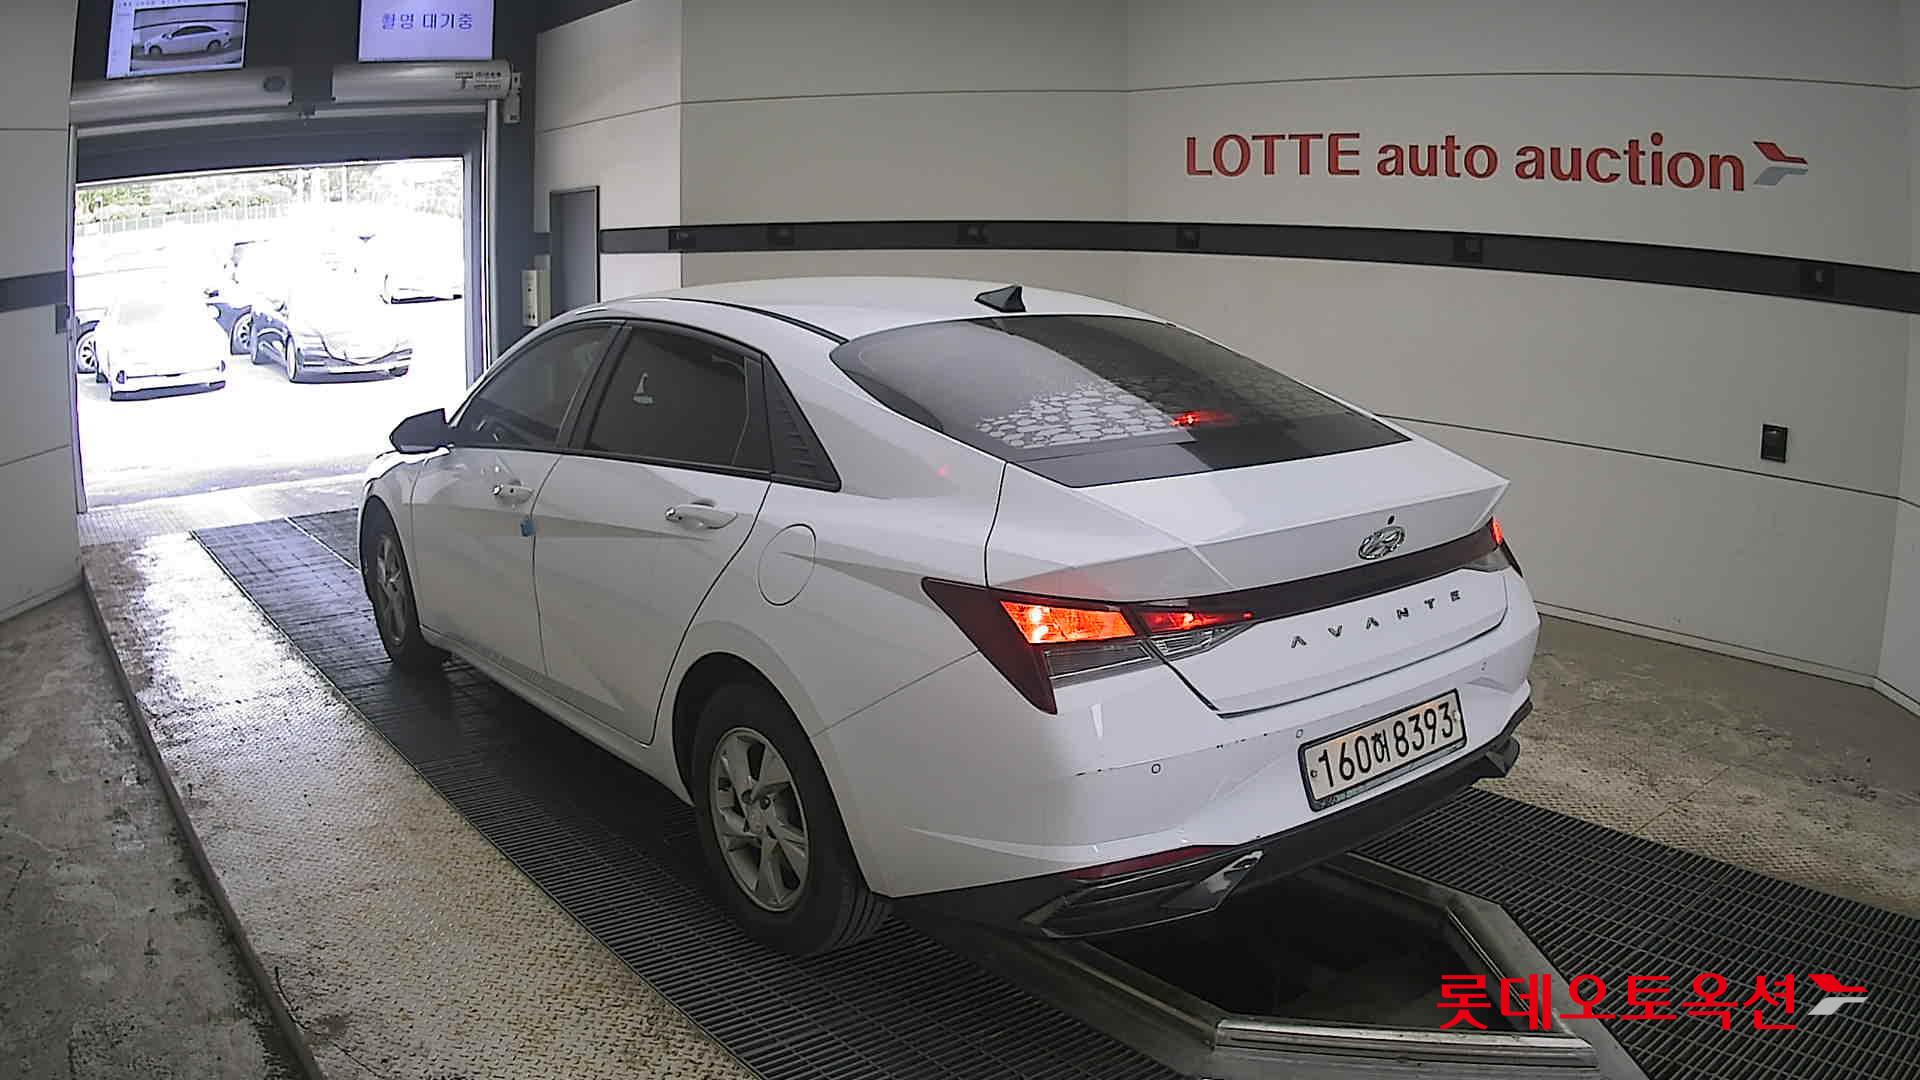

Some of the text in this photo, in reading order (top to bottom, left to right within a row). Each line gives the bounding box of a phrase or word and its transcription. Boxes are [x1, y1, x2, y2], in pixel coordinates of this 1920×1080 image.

[423, 13, 472, 30] 대기중
[1187, 132, 1744, 191] LOTTE auto auction
[1290, 590, 1461, 649] AVANTE
[1318, 702, 1454, 788] 160허 8393
